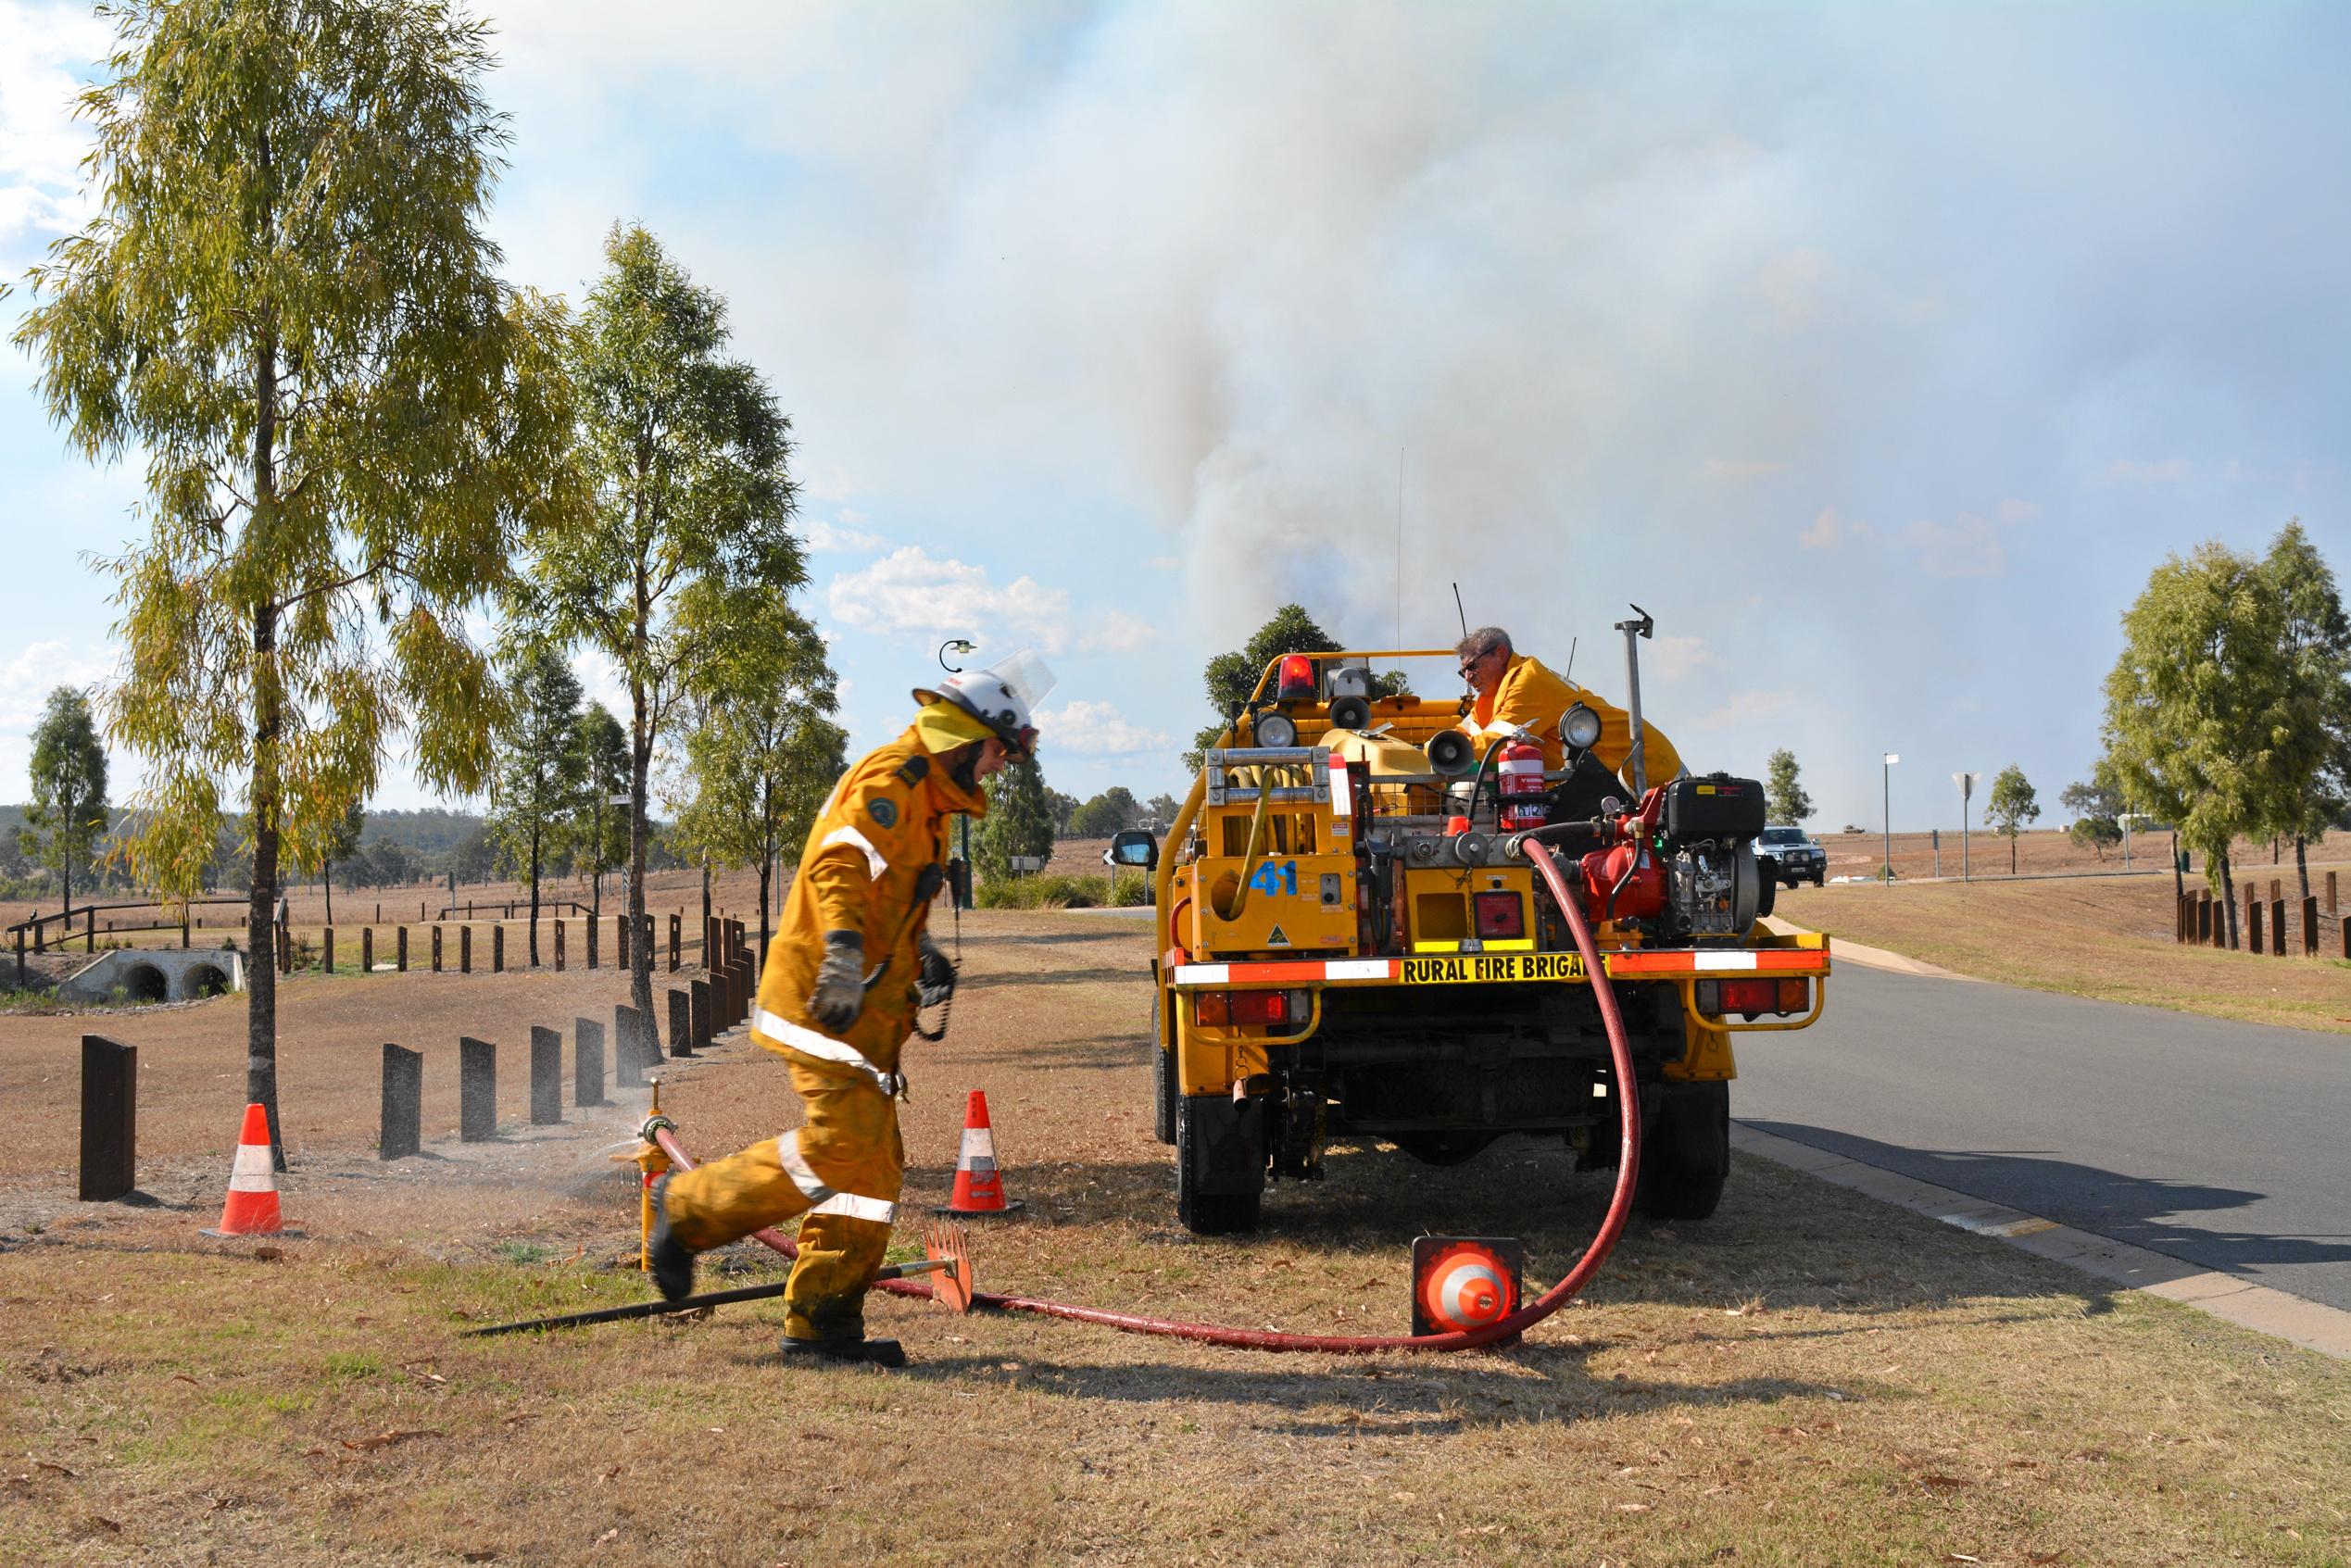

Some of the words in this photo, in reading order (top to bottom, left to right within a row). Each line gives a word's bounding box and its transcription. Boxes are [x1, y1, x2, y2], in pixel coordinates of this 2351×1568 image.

[1250, 860, 1297, 896] 41
[1403, 959, 1467, 982] RURAL
[1475, 957, 1515, 979] FIRE
[1522, 955, 1605, 978] BRIGA
